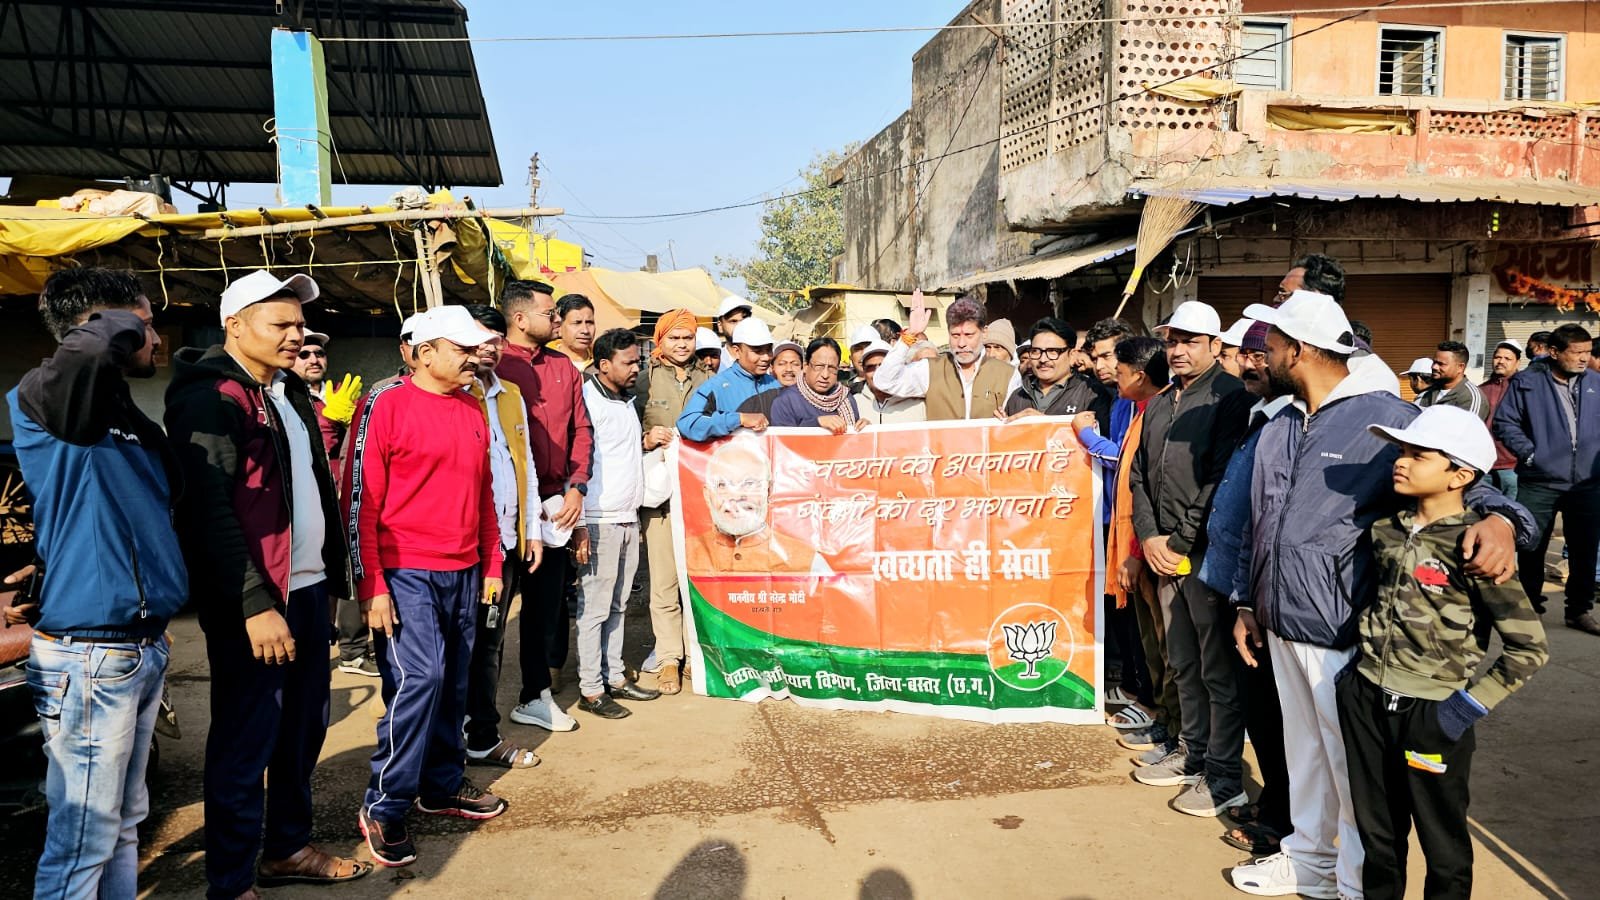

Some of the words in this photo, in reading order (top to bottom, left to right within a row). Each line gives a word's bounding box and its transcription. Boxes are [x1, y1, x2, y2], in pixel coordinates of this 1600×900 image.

[901, 446, 943, 477] को
[943, 450, 1047, 478] अपनाना
[1049, 439, 1075, 473] है
[875, 491, 917, 520] को
[918, 498, 957, 527] दूर
[960, 495, 1052, 519] भगाना
[1050, 485, 1079, 519] है
[870, 549, 954, 582] स्वच्छता
[961, 539, 992, 581] ही
[997, 539, 1052, 580] सेवा
[757, 590, 767, 604] श्री
[788, 589, 806, 604] मोदी
[815, 670, 861, 695] विभाग,
[865, 672, 940, 694] जिला-बस्तर
[947, 673, 995, 702] (छ.ग.)
